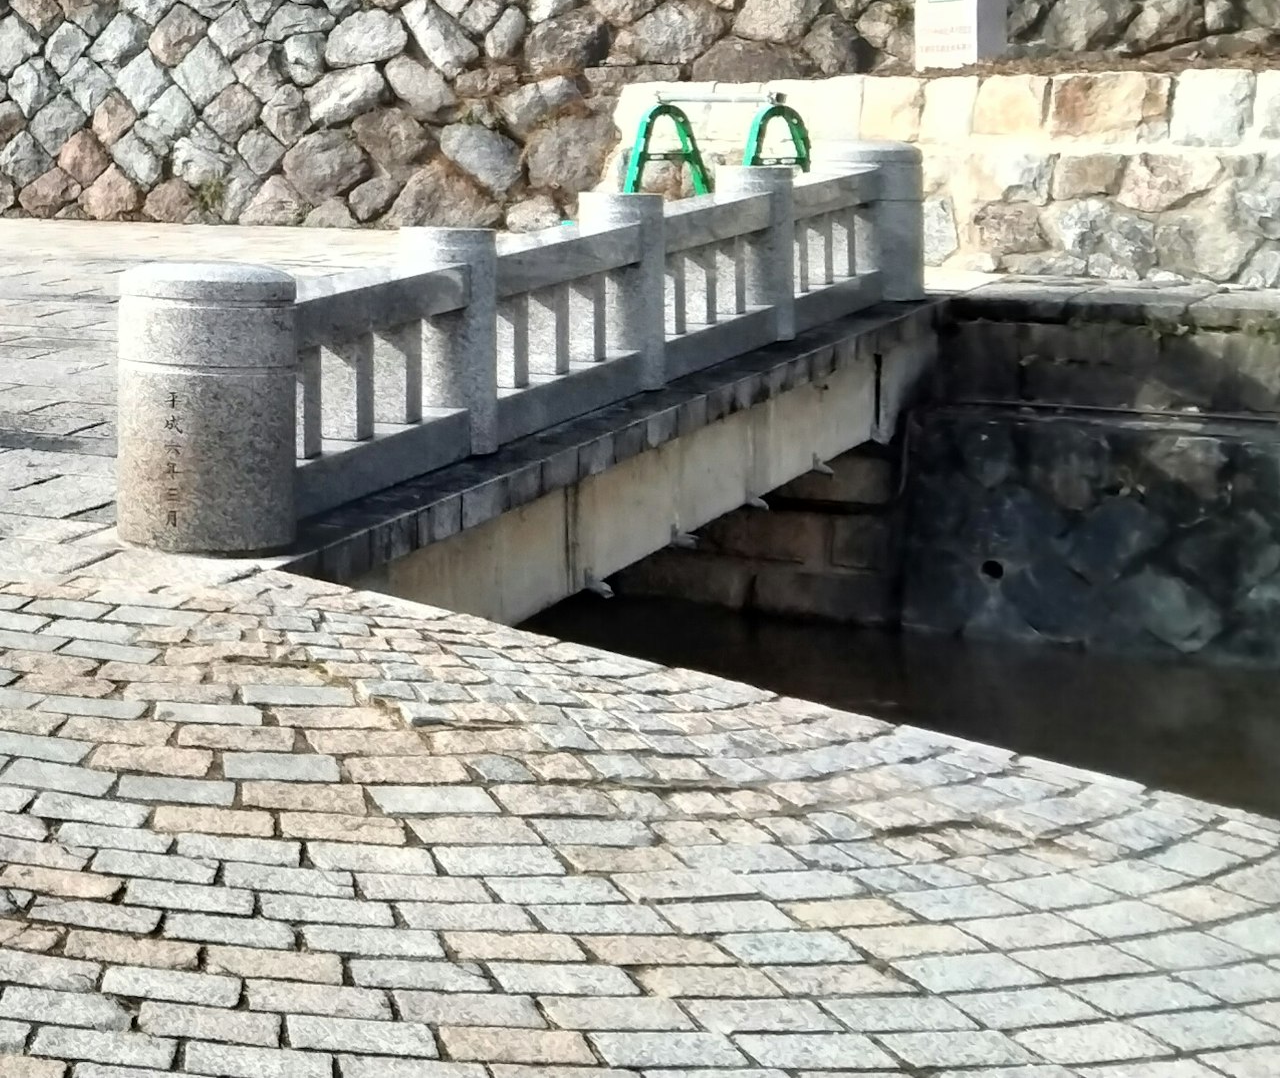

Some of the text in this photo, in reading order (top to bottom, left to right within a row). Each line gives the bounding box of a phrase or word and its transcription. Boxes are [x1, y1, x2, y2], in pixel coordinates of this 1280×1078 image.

[164, 391, 183, 528] 平成六年三月
